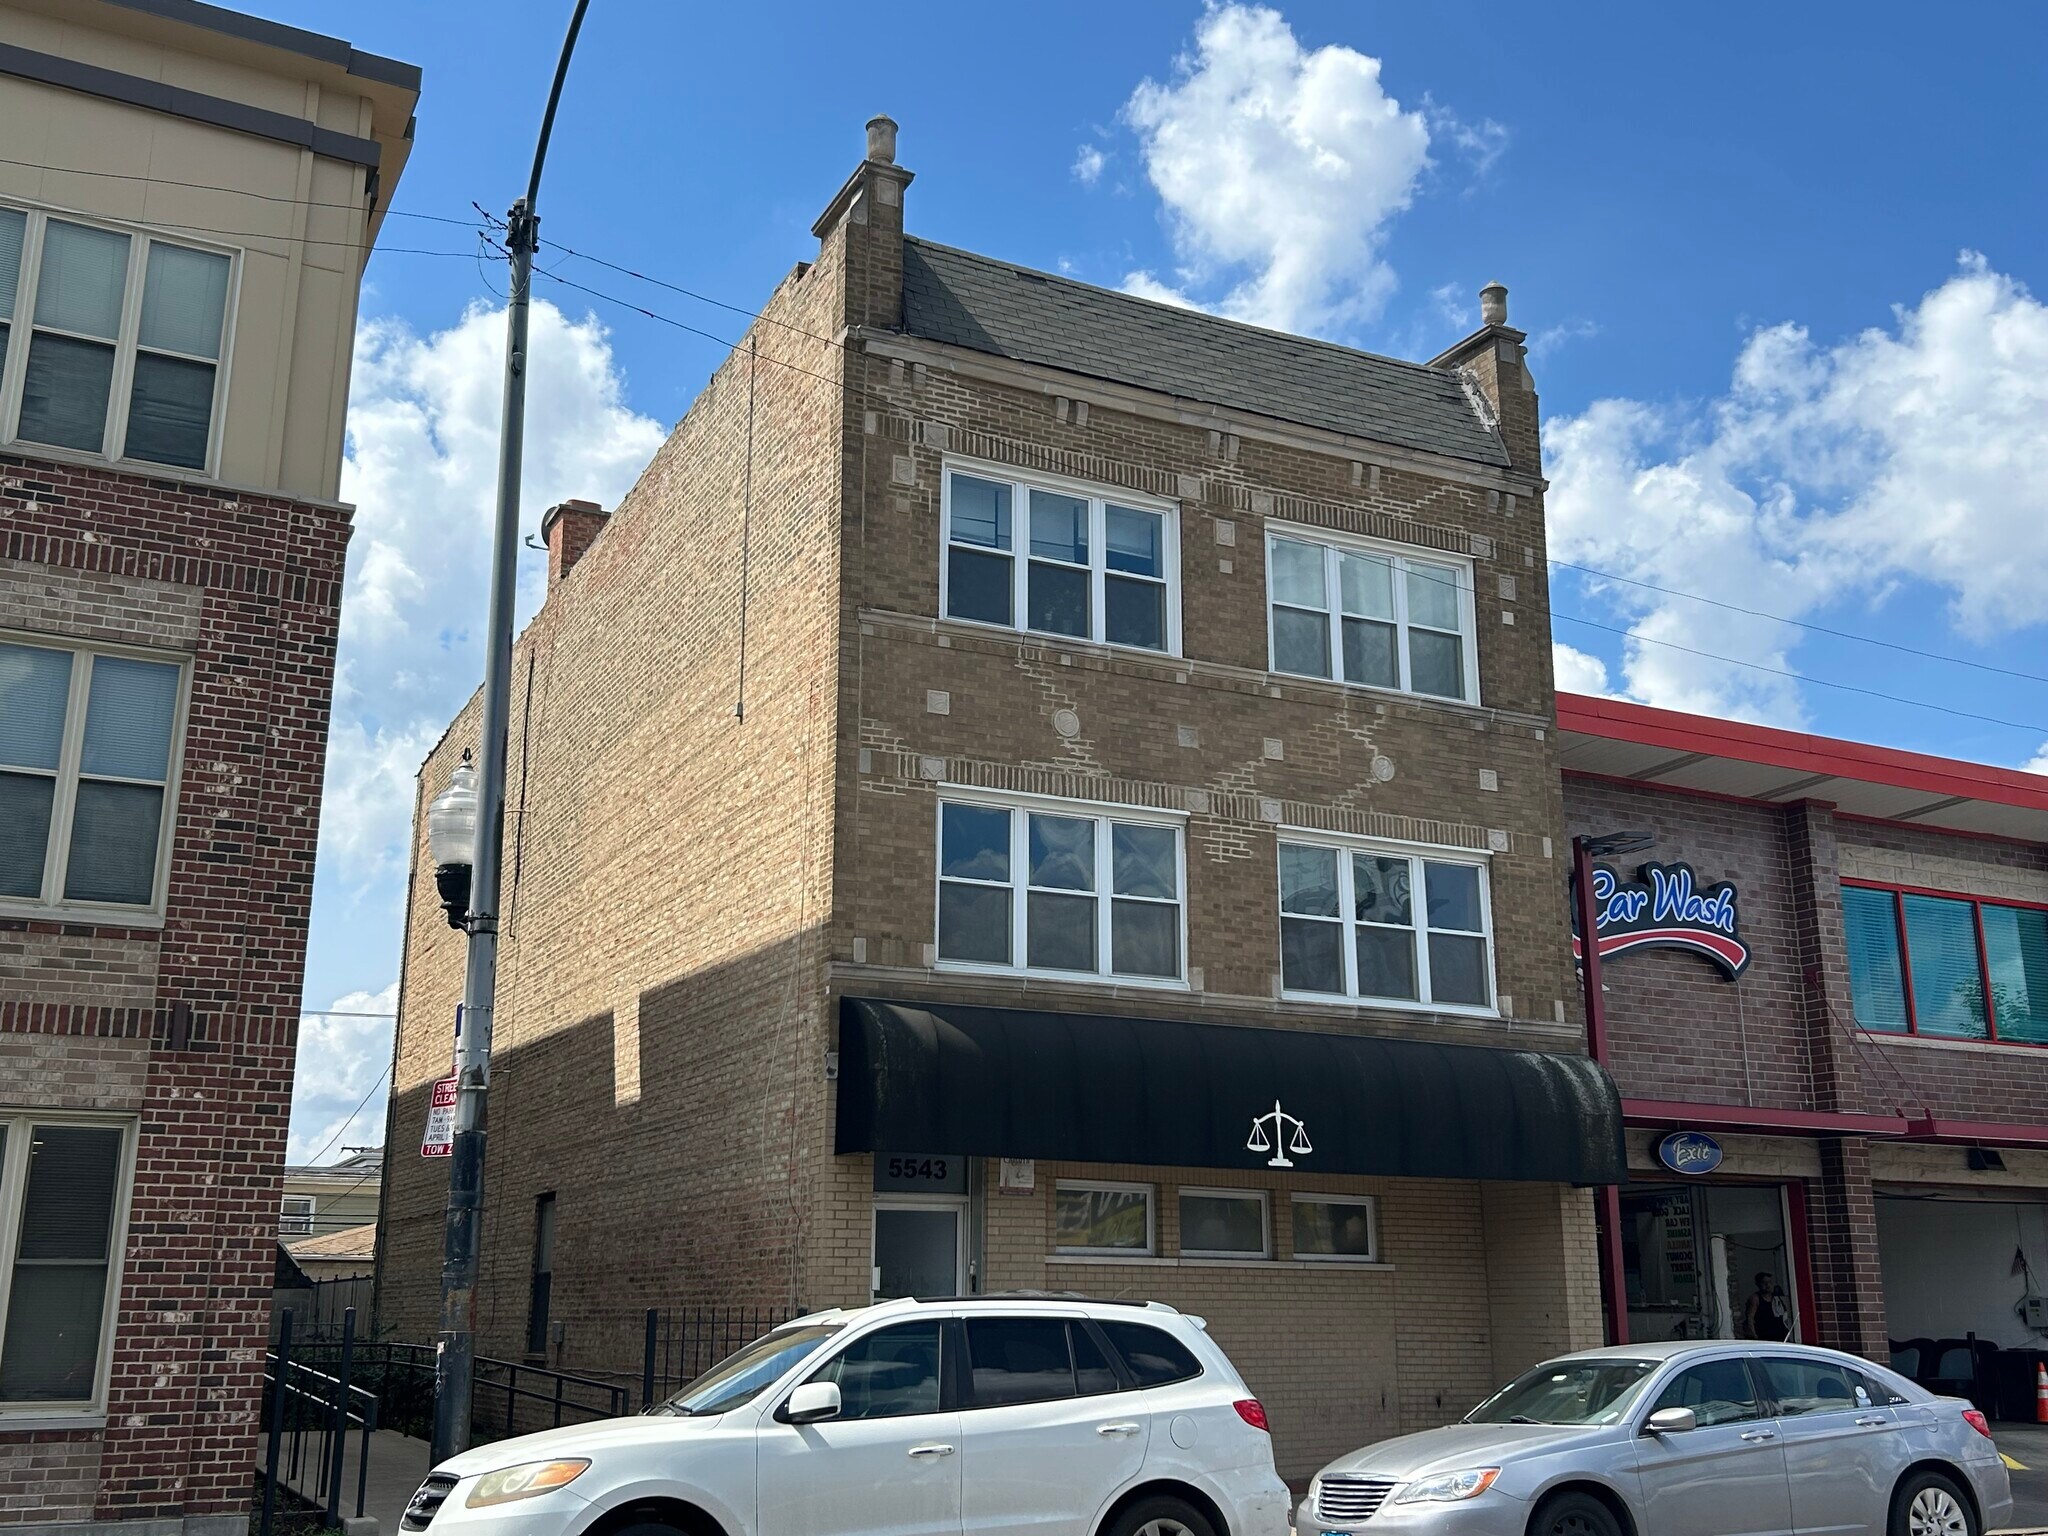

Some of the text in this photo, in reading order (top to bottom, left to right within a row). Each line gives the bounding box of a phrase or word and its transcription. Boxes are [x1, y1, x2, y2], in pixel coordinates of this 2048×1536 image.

[1651, 868, 1734, 933] Wash
[437, 1083, 457, 1093] STREE
[430, 1124, 445, 1133] TUES
[428, 1133, 444, 1141] APRIL
[426, 1145, 444, 1154] TOW
[1672, 1135, 1710, 1166] Exit
[888, 1157, 947, 1180] 5543
